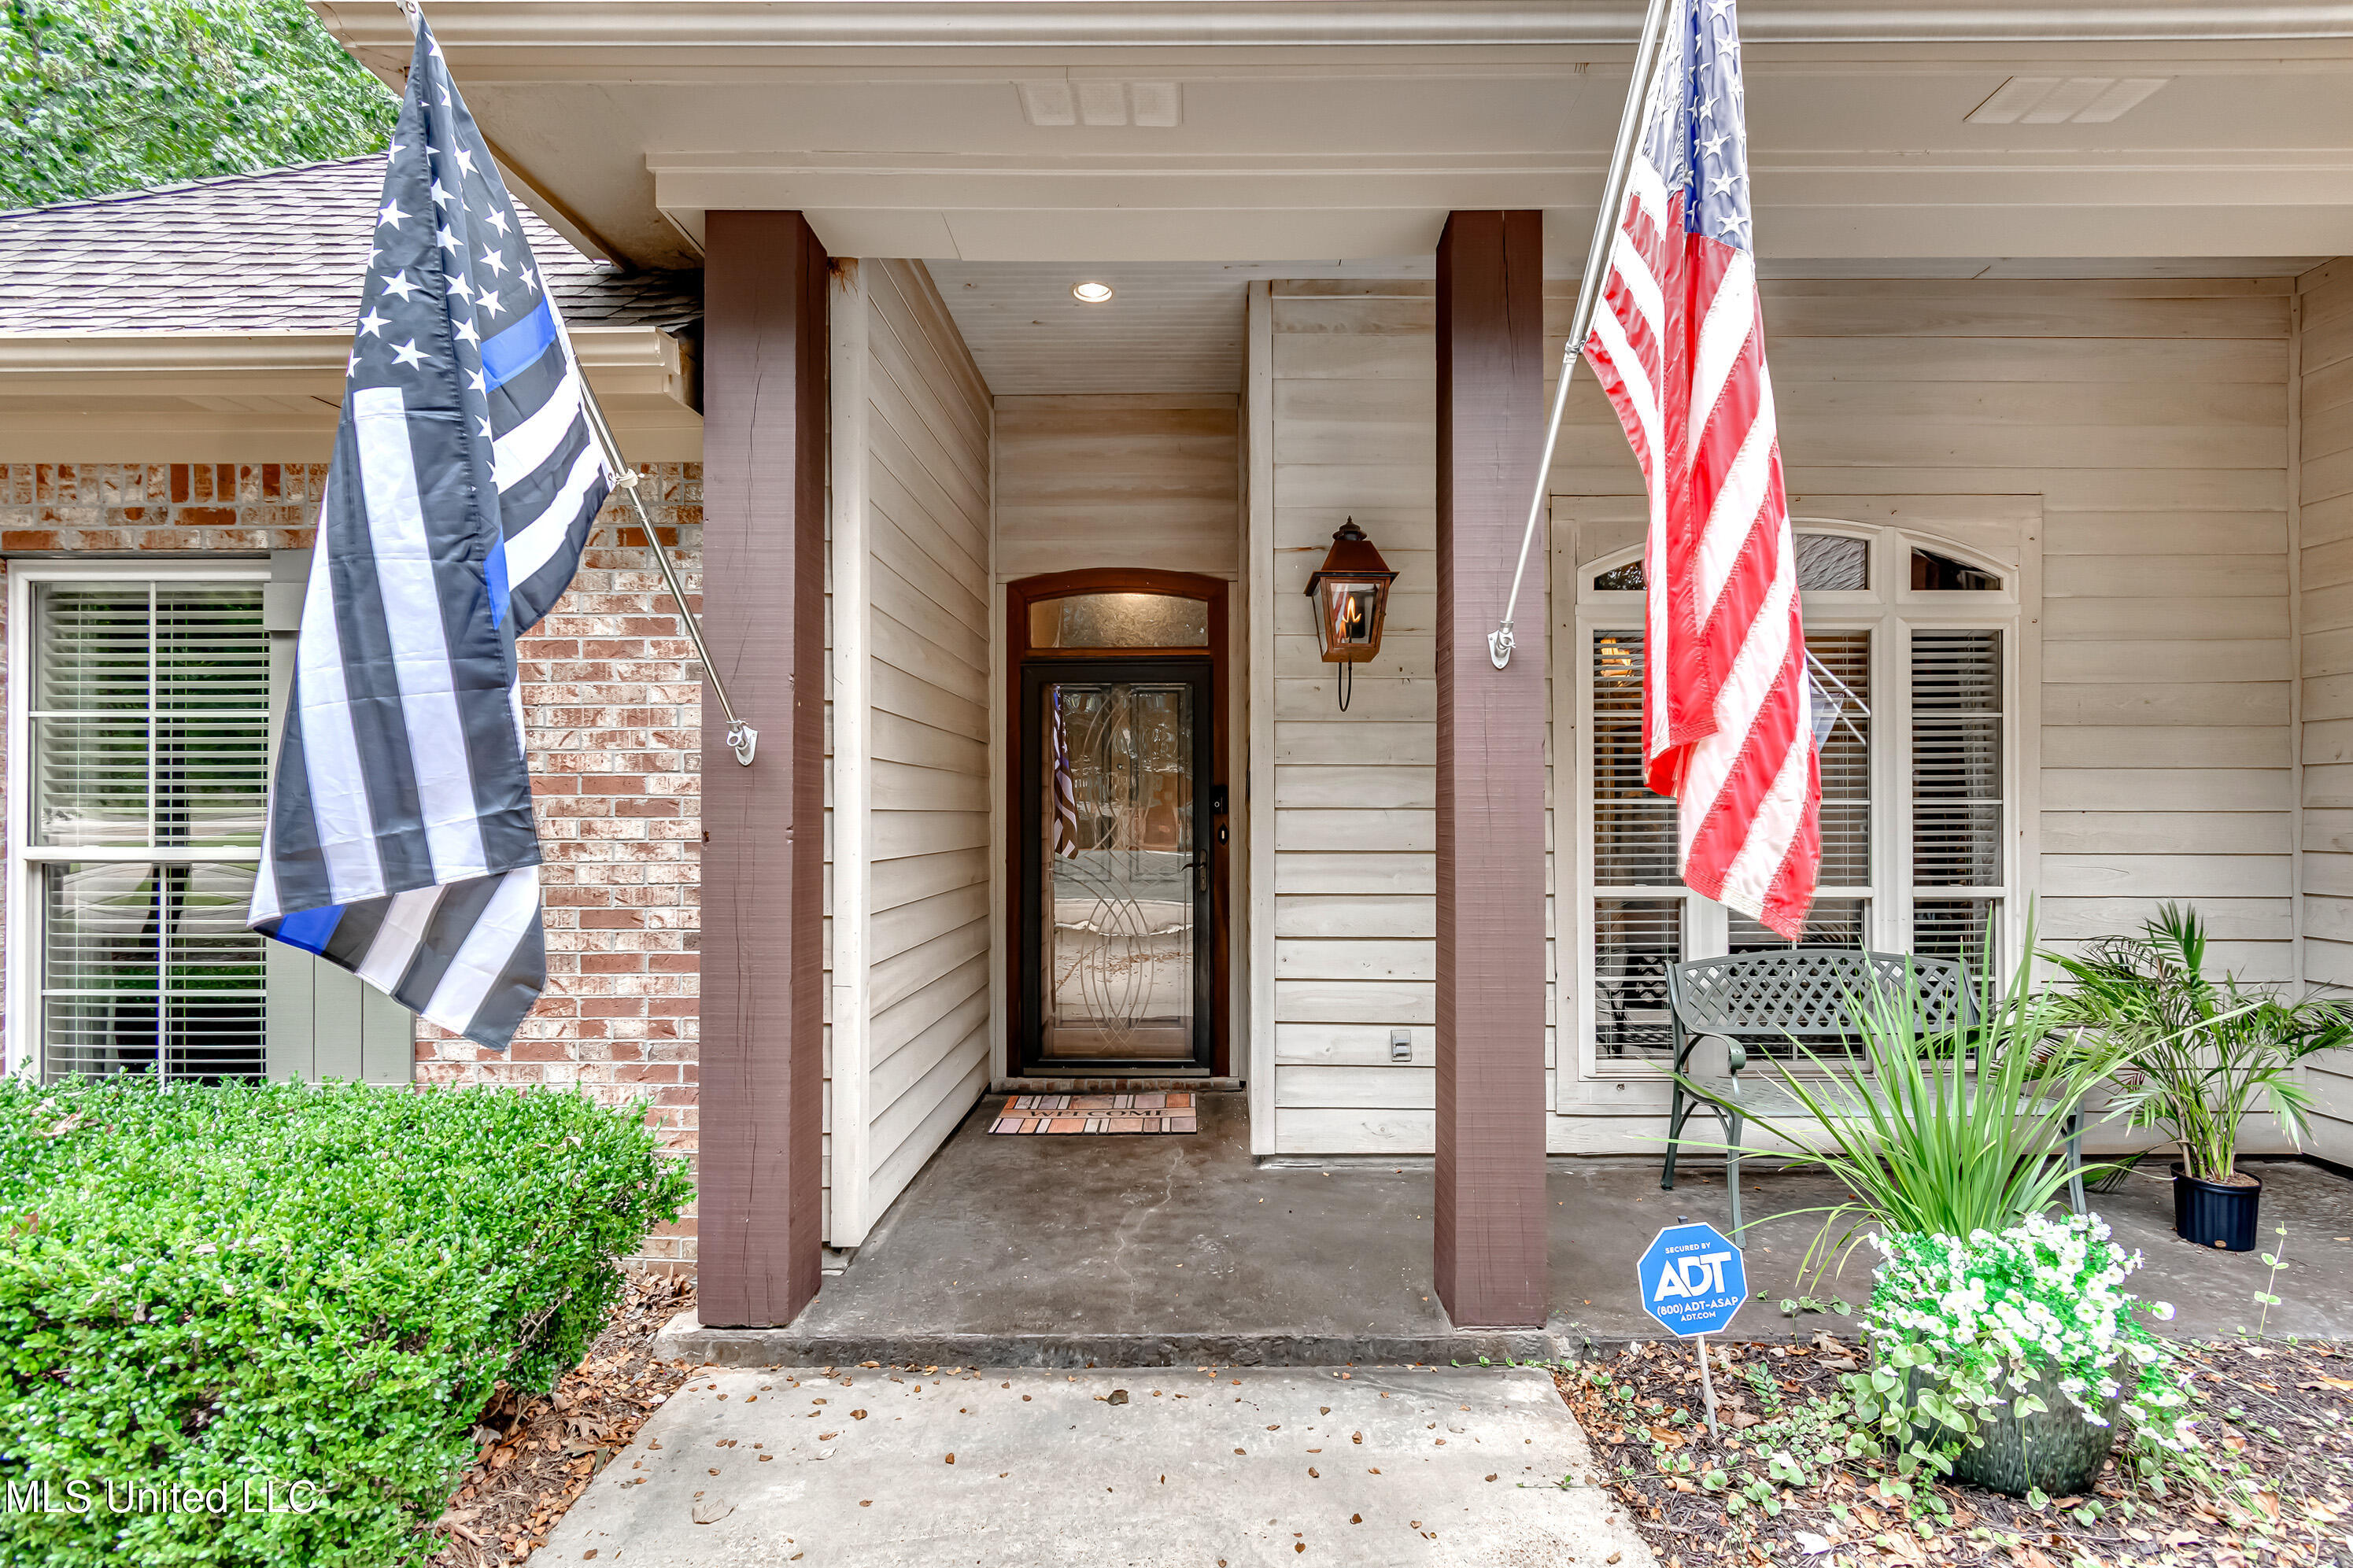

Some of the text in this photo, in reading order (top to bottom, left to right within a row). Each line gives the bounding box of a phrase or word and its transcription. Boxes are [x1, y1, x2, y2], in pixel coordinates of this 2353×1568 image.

[1664, 1244, 1700, 1254] SECURED
[1653, 1251, 1731, 1302] ADT
[1657, 1296, 1738, 1317] (800) ADT-ASAP
[1681, 1311, 1716, 1322] ADT.COM
